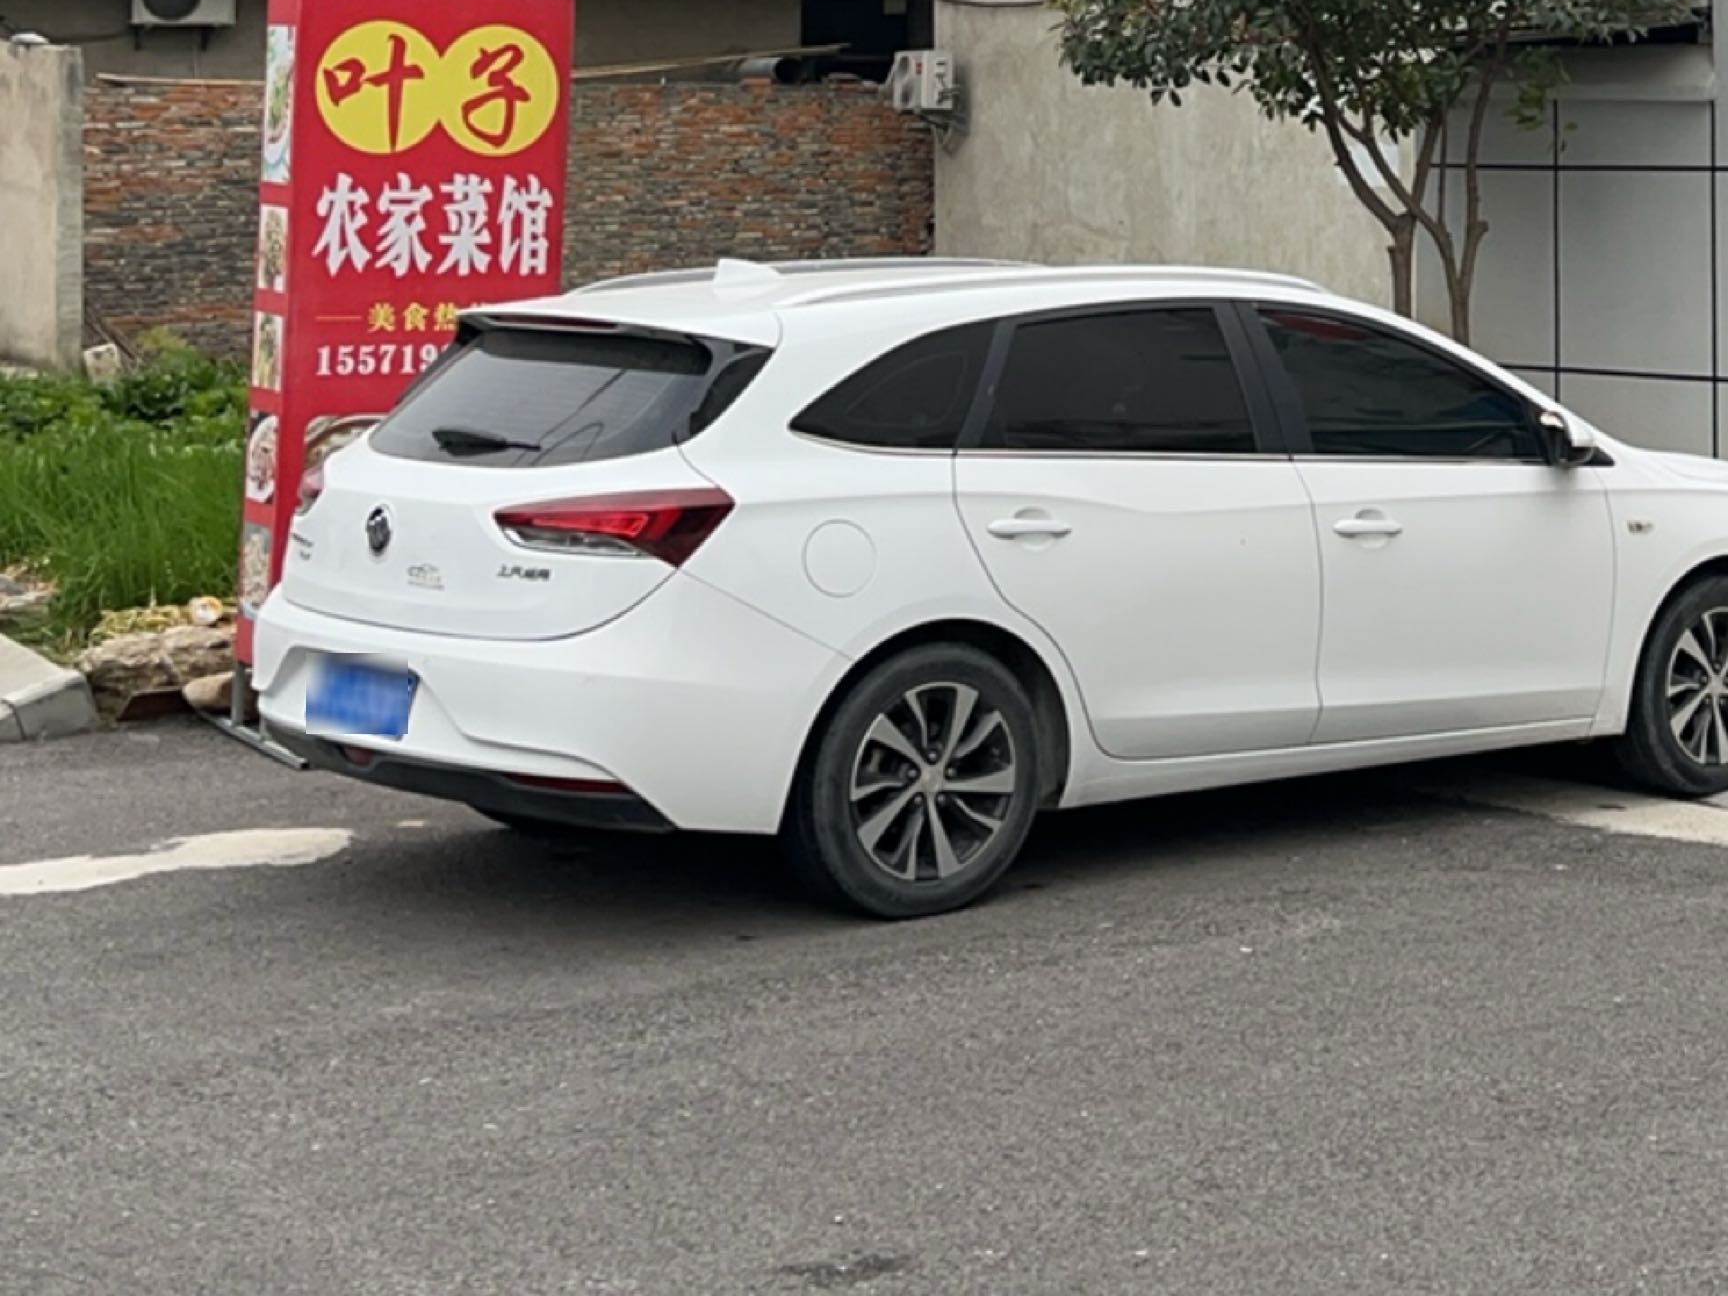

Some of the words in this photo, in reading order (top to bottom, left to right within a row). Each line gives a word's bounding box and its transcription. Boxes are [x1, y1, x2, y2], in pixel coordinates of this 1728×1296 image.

[323, 33, 532, 153] 叶子
[312, 172, 553, 278] 农家菜馆
[367, 301, 488, 333] 美食热
[315, 343, 451, 376] 155719
